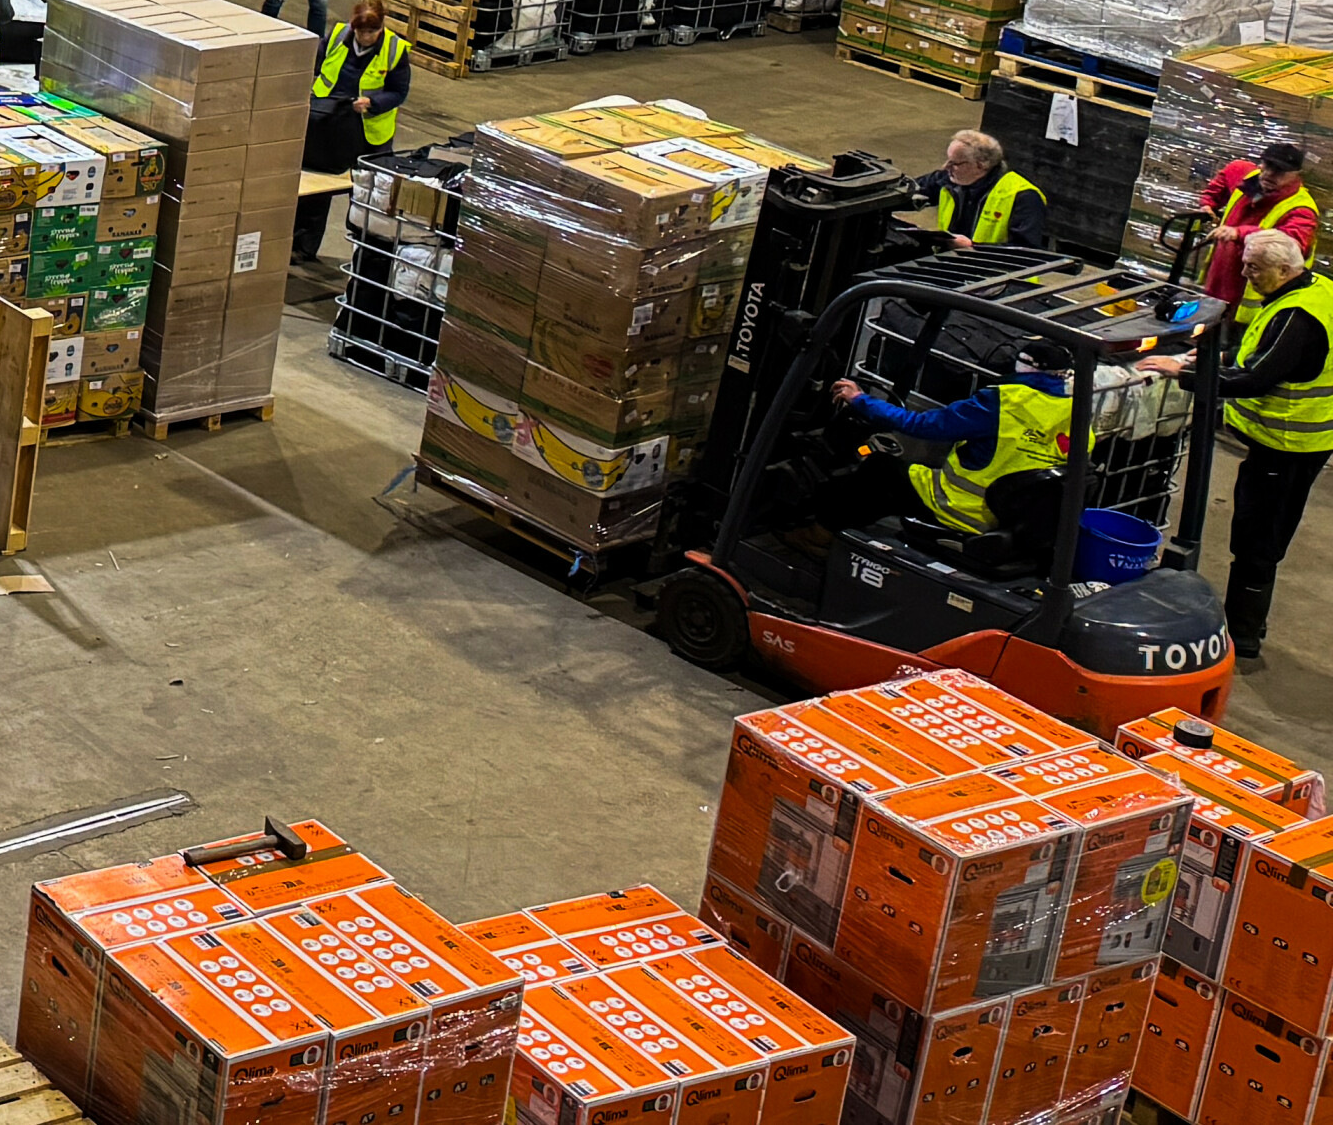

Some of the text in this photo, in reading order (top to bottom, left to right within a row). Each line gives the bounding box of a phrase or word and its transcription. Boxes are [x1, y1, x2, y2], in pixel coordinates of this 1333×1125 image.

[736, 282, 766, 352] TOYOTA
[850, 561, 884, 589] 18
[762, 630, 796, 654] SAS
[1138, 625, 1228, 671] TOYOT
[866, 817, 905, 850] Qlima
[1255, 859, 1290, 886] Qlim
[1231, 1001, 1267, 1029] Qlim
[339, 1039, 379, 1063] Qlima
[234, 1063, 275, 1085] Qlima
[773, 1062, 810, 1083] Qlima
[685, 1087, 722, 1107] Qlima
[591, 1108, 629, 1125] Qlima
